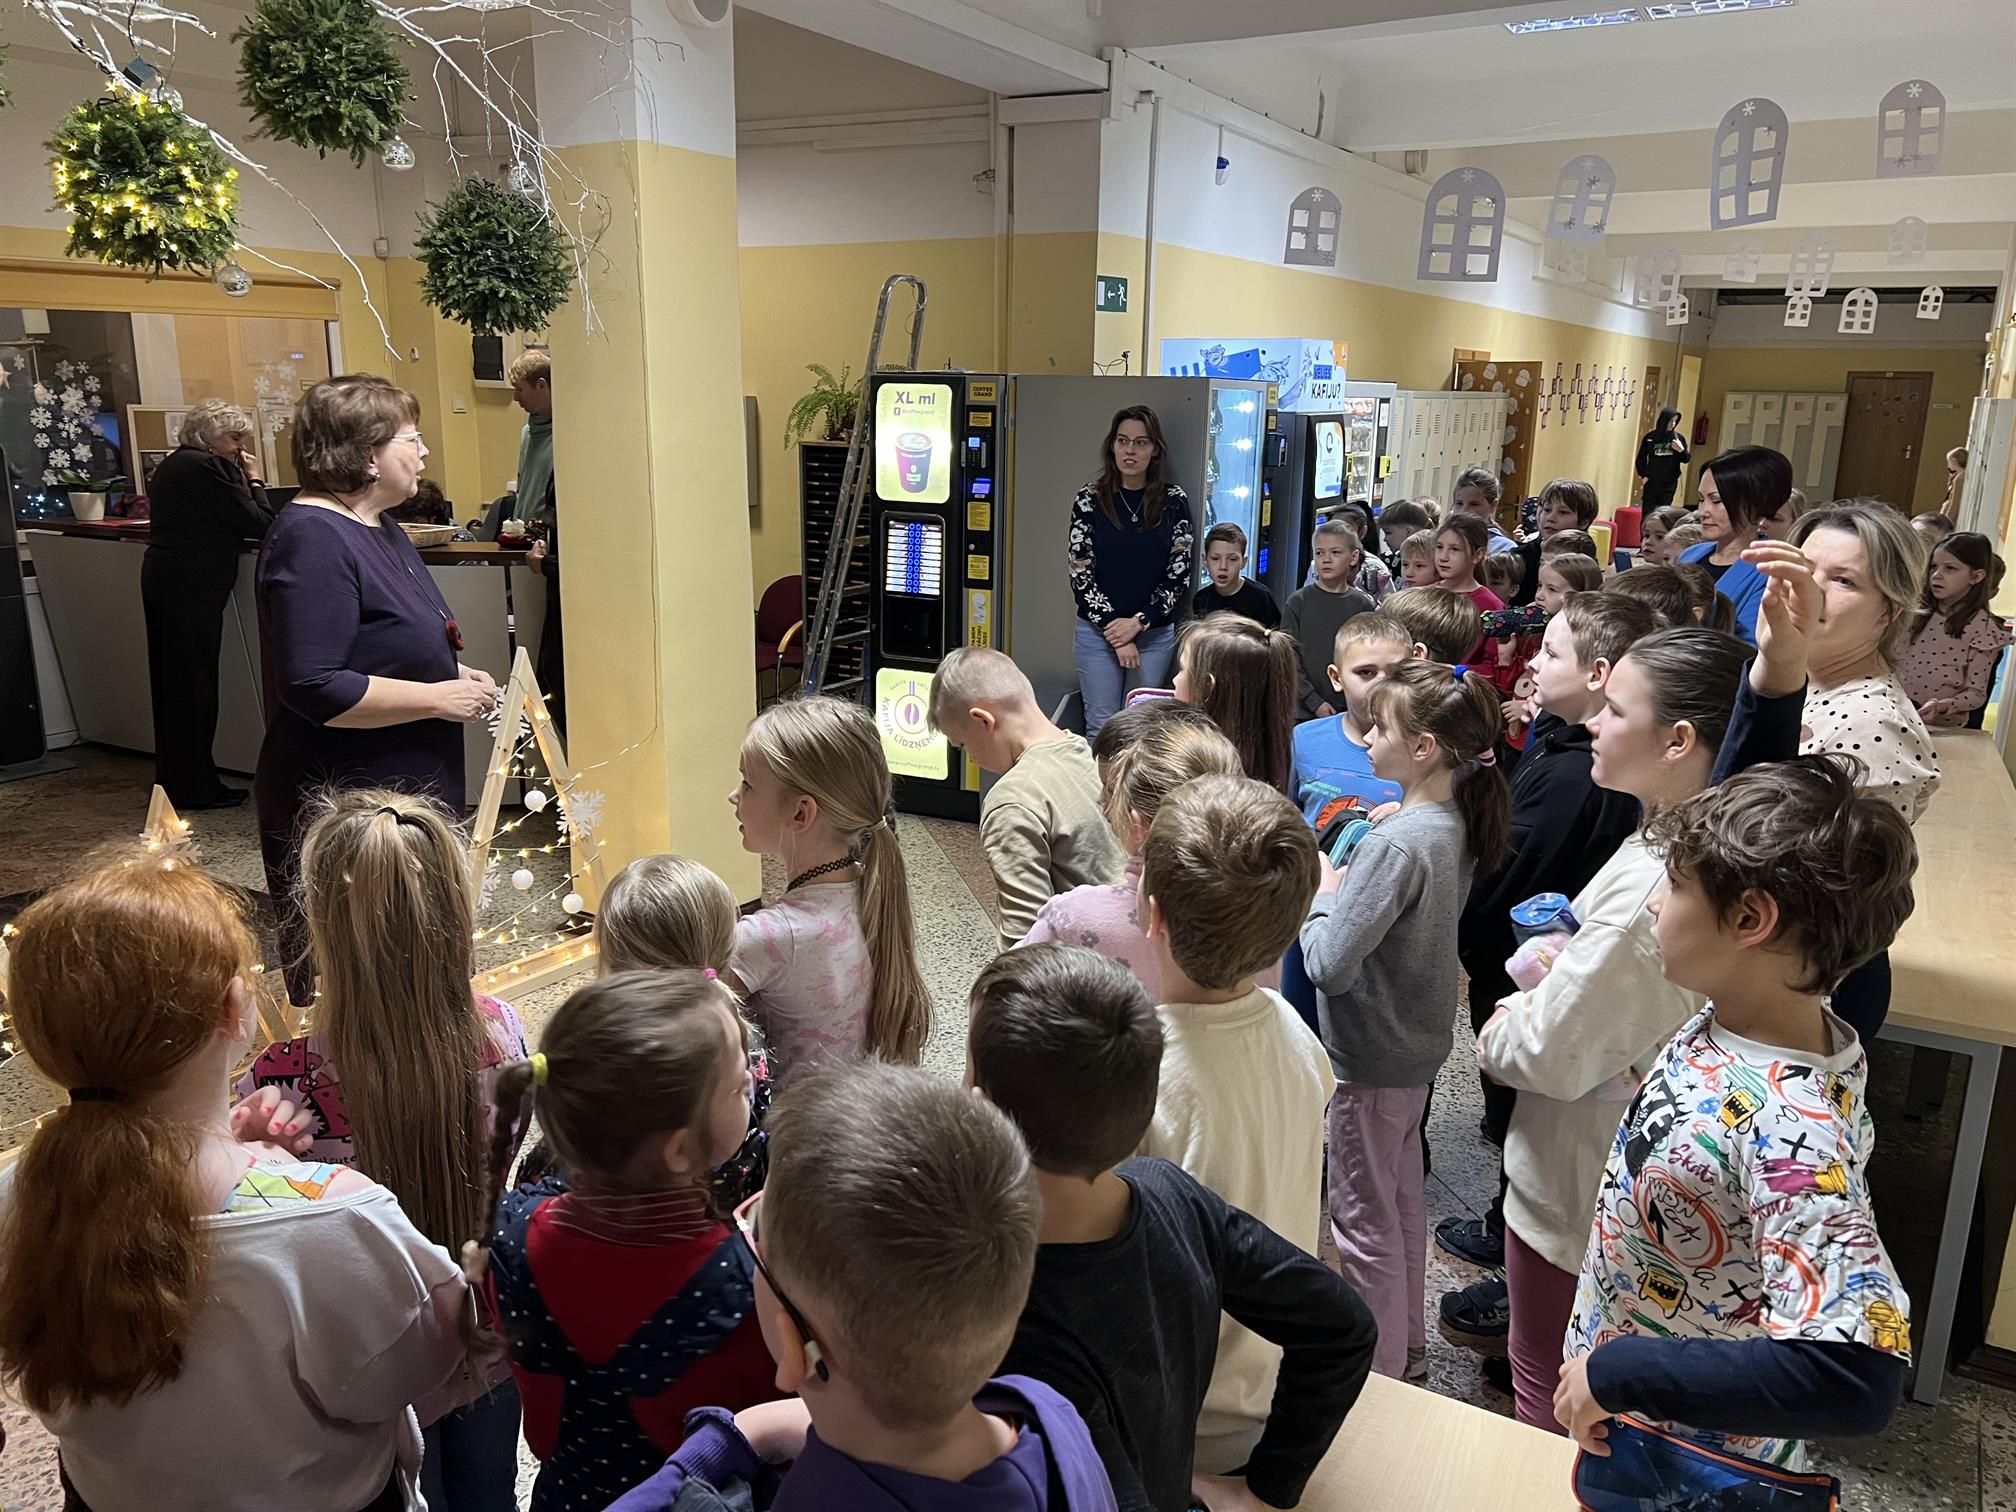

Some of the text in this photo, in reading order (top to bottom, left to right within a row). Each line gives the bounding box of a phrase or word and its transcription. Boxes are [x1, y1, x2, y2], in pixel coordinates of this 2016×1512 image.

[895, 391, 936, 405] XL ml
[1311, 383, 1341, 399] KAFIJU?
[882, 697, 893, 735] KAFIJA
